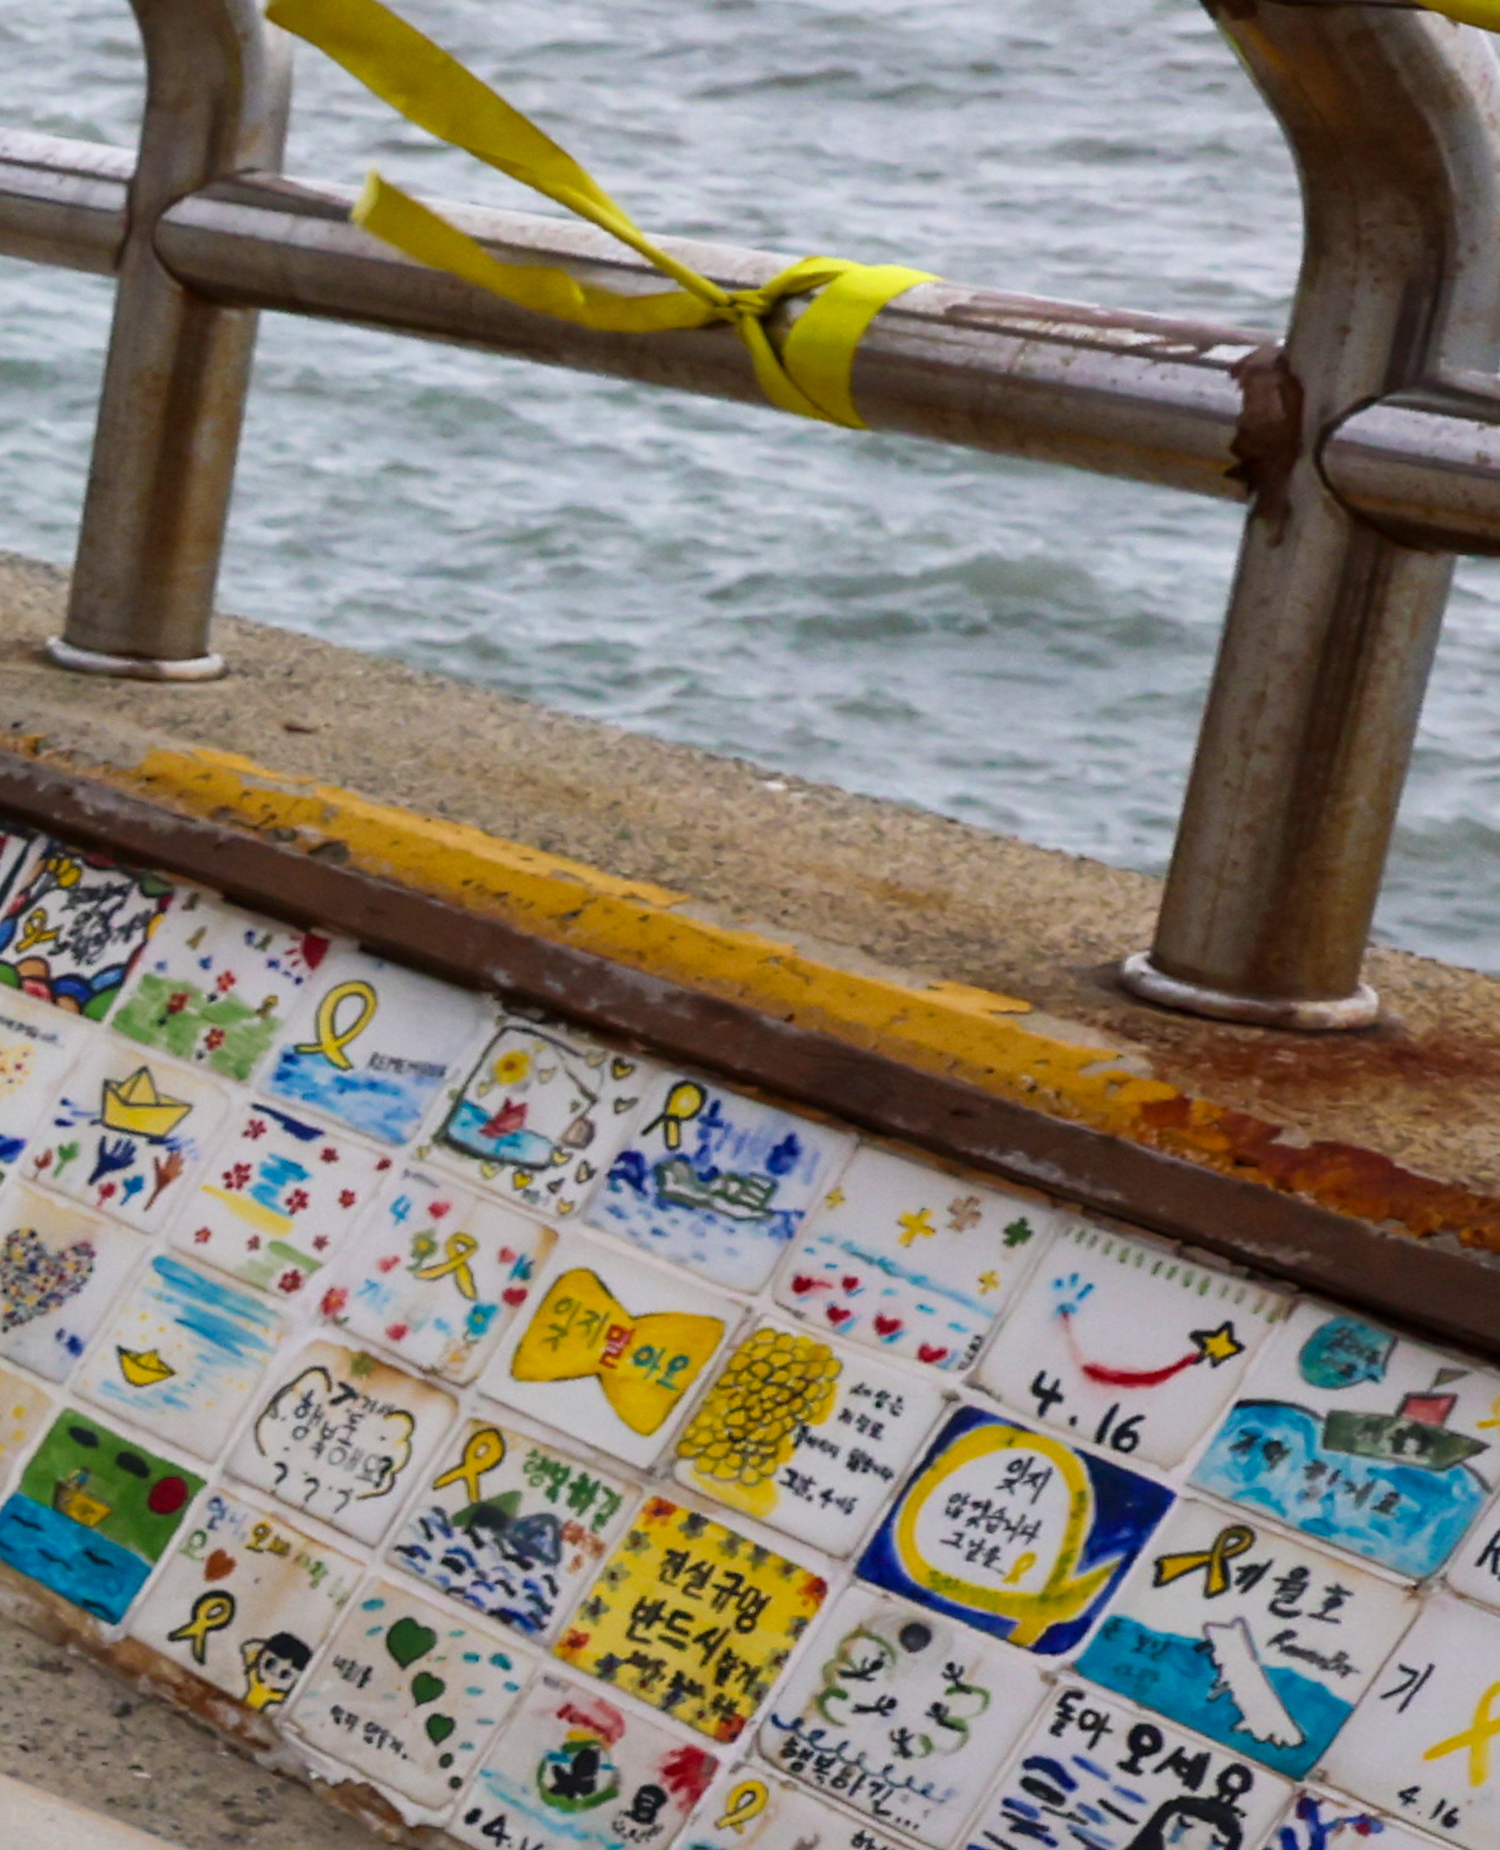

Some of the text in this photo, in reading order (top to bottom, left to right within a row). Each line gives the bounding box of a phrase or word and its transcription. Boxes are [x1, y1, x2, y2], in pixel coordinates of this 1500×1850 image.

[1029, 1368, 1146, 1454] 4.16
[994, 1455, 1054, 1504] 잊지
[658, 1547, 772, 1634] 진실규명
[626, 1595, 732, 1667] 반드시
[1049, 1692, 1257, 1821] 돌아 오세요
[1398, 1785, 1461, 1829] 4.16
